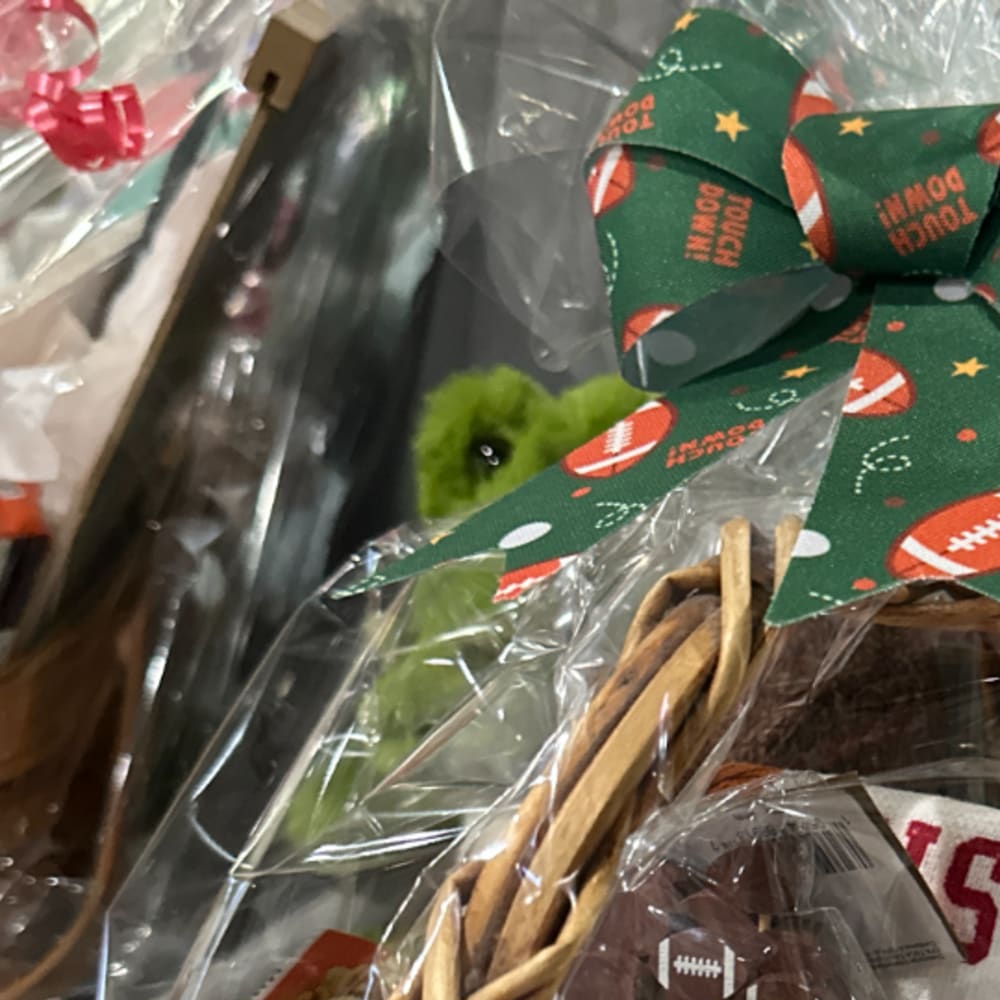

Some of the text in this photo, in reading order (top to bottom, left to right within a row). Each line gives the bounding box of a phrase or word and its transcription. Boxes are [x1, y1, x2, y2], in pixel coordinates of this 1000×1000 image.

[684, 181, 726, 262] DOWN!
[874, 165, 967, 230] DOWN!
[888, 195, 979, 256] TOUCH
[712, 193, 753, 269] TOUCH
[665, 435, 746, 469] OUCH
